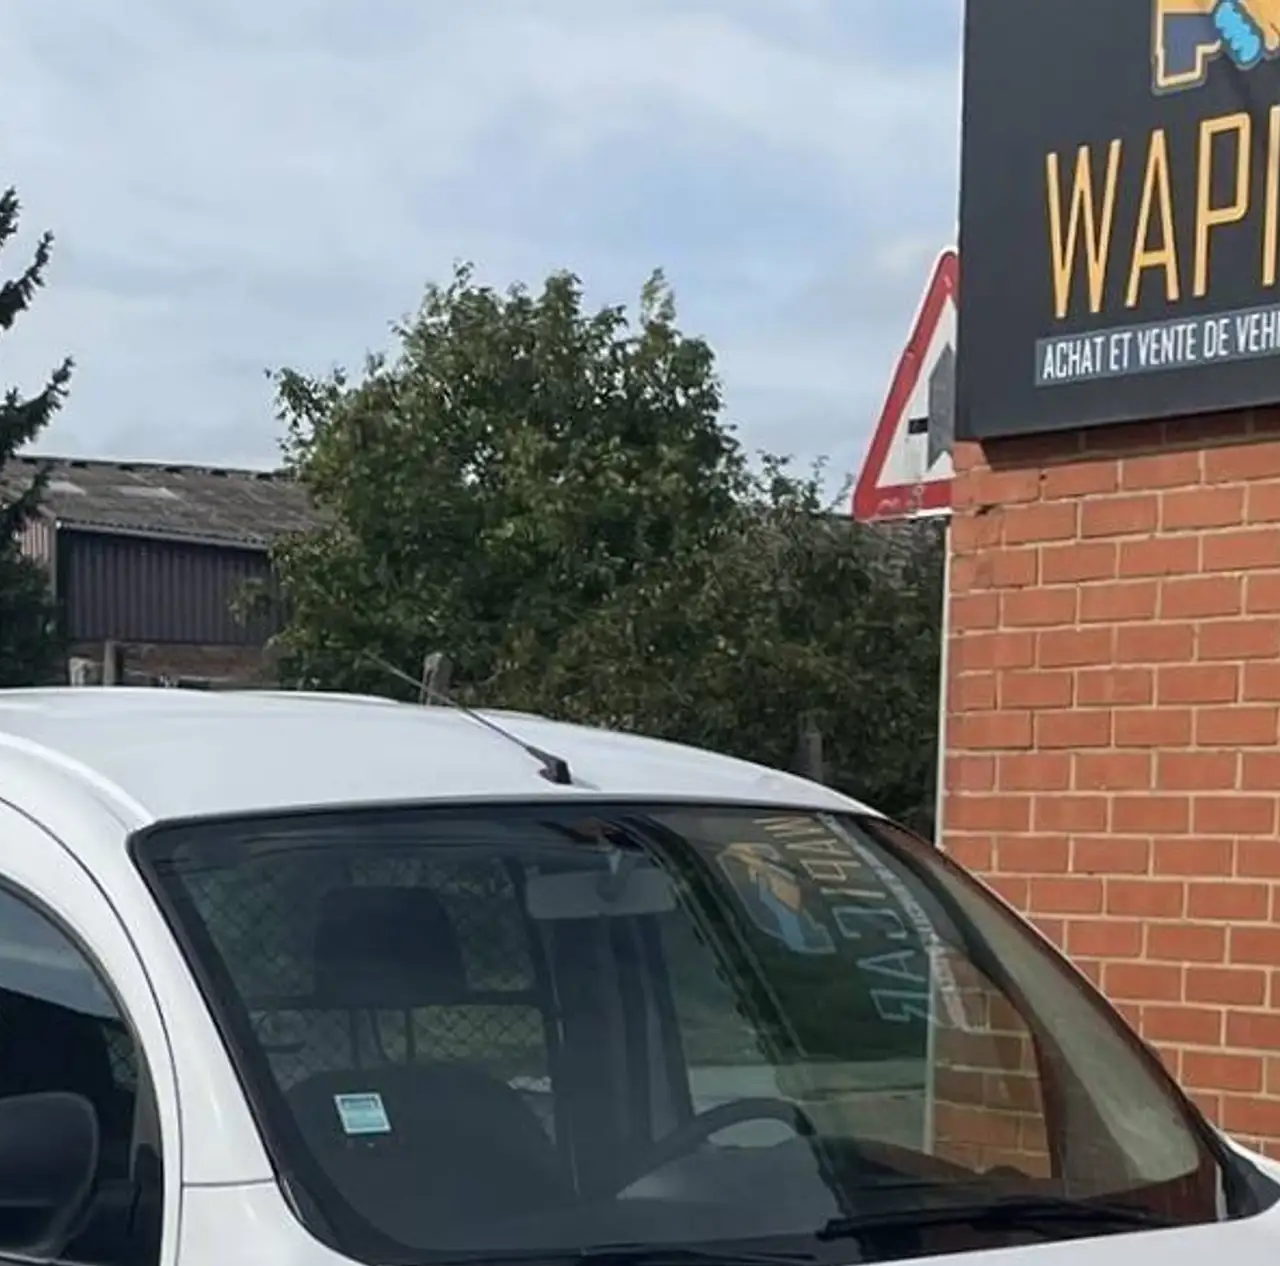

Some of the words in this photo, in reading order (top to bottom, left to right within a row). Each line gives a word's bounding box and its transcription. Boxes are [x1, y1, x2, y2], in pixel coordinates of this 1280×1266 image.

[1042, 335, 1106, 380] ACHAT
[1109, 331, 1133, 372] ET
[1136, 322, 1199, 367] VENTE
[1203, 317, 1231, 359] DE
